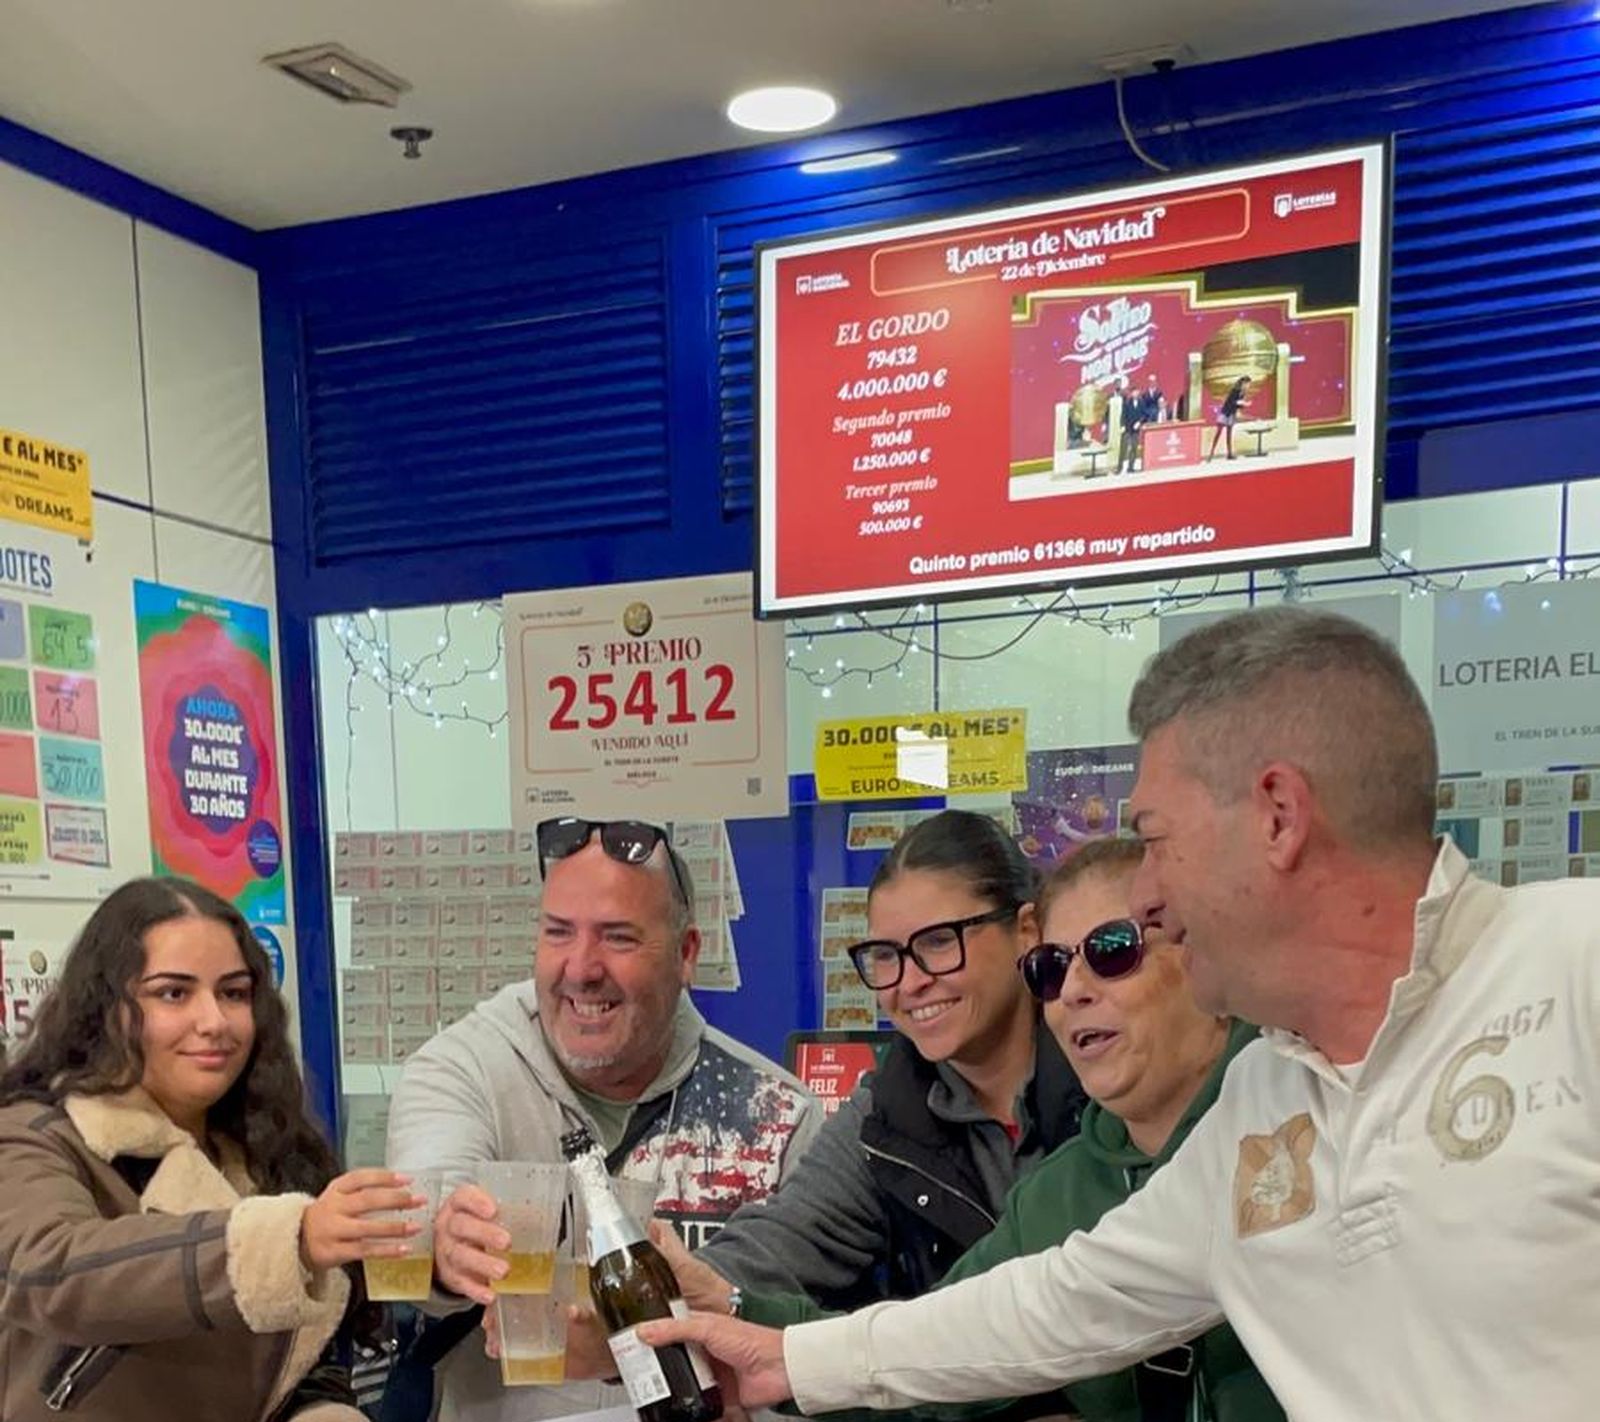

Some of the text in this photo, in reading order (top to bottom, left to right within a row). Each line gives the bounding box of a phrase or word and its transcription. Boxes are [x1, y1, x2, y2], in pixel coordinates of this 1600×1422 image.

[1032, 231, 1060, 258] de
[1063, 207, 1166, 251] Navidad
[1001, 265, 1019, 281] 22
[1036, 251, 1106, 277] Diciembre
[836, 308, 950, 346] EL GORDO
[867, 345, 918, 370] 79432
[837, 368, 948, 401] 4.000.000 €
[832, 402, 951, 436] Segundo premio
[17, 440, 39, 462] AL
[870, 429, 913, 448] 70048
[853, 447, 931, 472] 1.250.000 €
[845, 476, 938, 499] Tercer premio
[14, 494, 74, 522] DREAMS
[872, 498, 910, 514] 90693
[859, 515, 923, 535] 500.000 €
[909, 524, 1216, 575] Quinto premio 61366 muy repartido
[0, 548, 53, 589] OTES
[604, 637, 702, 666] PREMIO
[1438, 651, 1600, 687] LOTERIA EL
[186, 697, 238, 721] AHORA
[548, 664, 736, 730] 25412
[929, 722, 957, 739] AL
[1494, 731, 1507, 741] EL
[1512, 728, 1542, 740] TREN
[1545, 727, 1558, 738] DE
[1562, 726, 1577, 738] LA
[592, 736, 651, 751] VENDIDO
[191, 745, 239, 769] AL MES
[184, 769, 248, 795] DURANTE
[851, 777, 900, 794] EURO
[190, 795, 246, 819] 30 AÑOS
[809, 1078, 838, 1095] FELIZ
